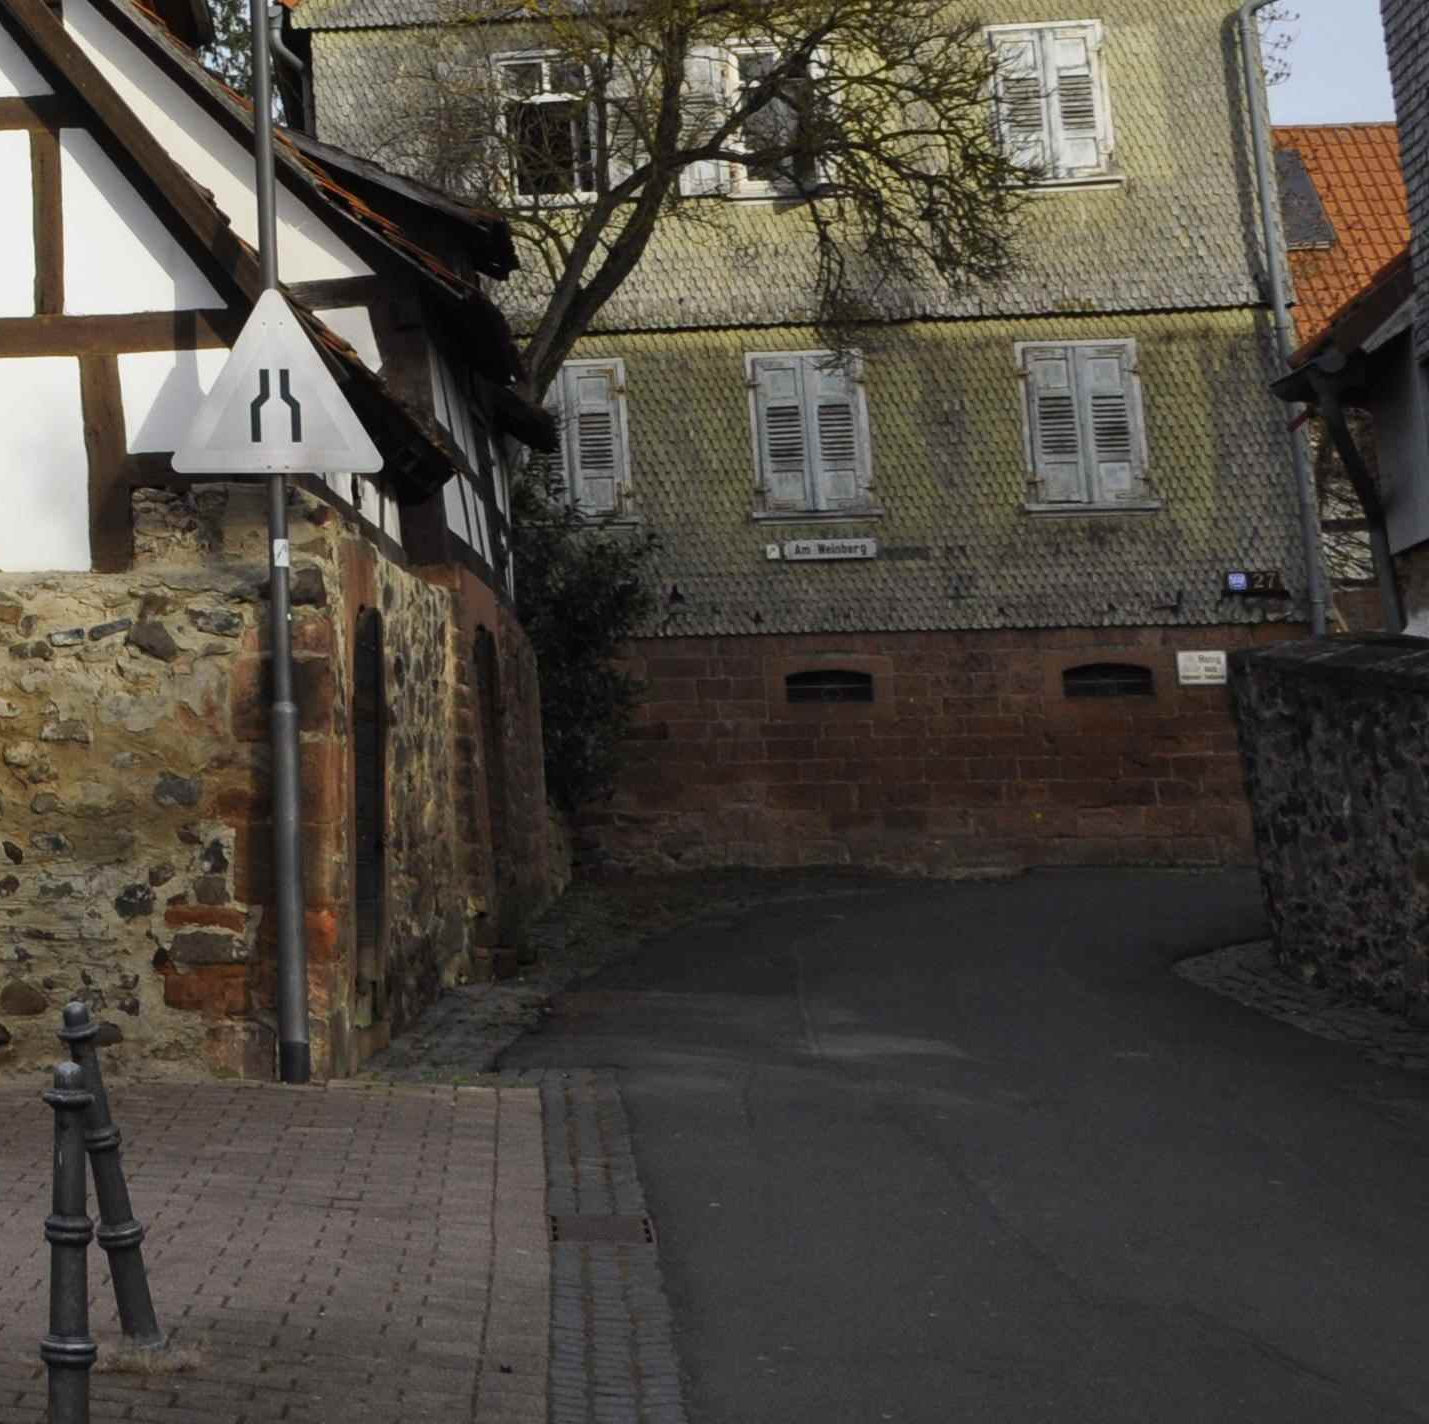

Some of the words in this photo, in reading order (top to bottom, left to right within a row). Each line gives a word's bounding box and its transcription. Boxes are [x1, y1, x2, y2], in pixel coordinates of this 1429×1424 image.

[795, 543, 811, 555] Am
[817, 543, 867, 556] Weinberg
[1253, 572, 1276, 589] 27
